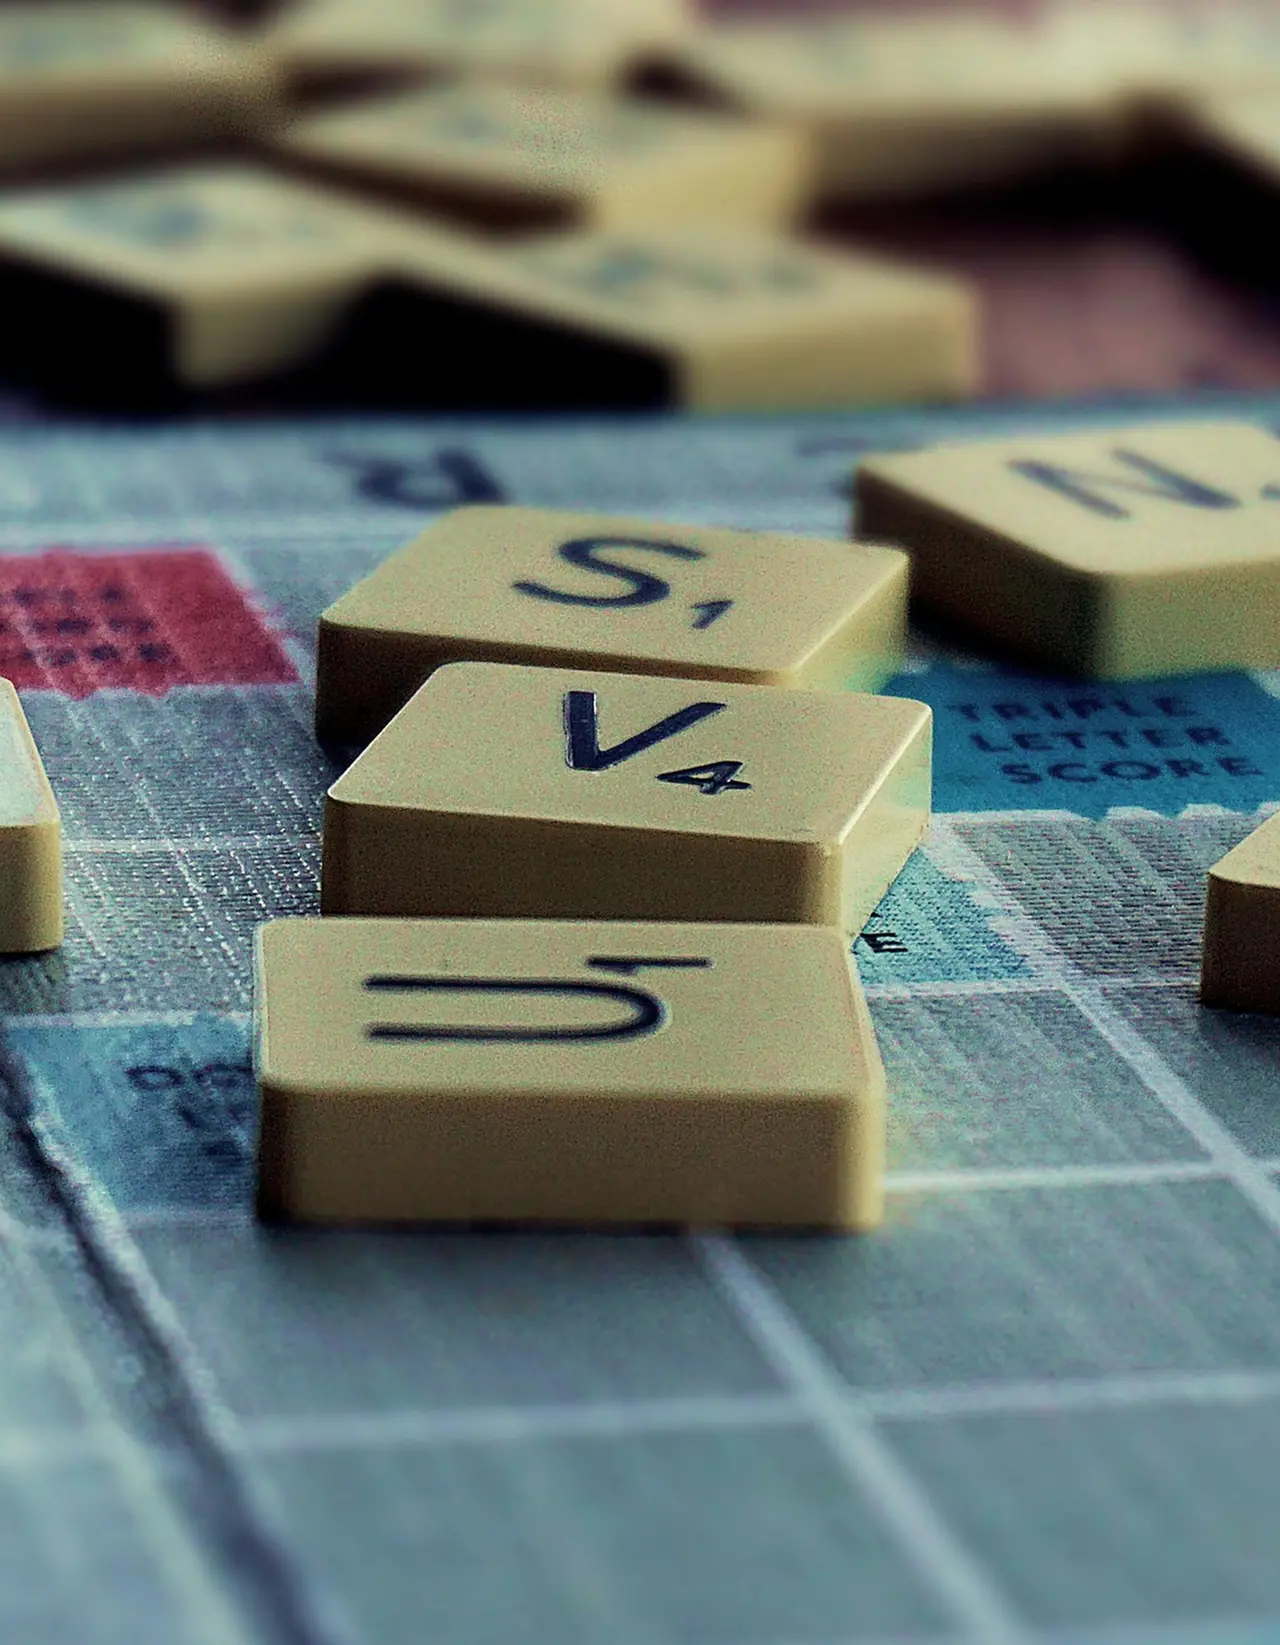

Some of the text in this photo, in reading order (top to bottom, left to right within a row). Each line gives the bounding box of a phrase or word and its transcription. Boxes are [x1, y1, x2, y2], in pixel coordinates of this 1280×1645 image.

[1006, 447, 1242, 520] N
[510, 536, 734, 630] S 1
[562, 690, 753, 796] V 4
[970, 728, 1232, 754] LETTER
[999, 756, 1265, 785] SCORE
[361, 972, 671, 1045] U
